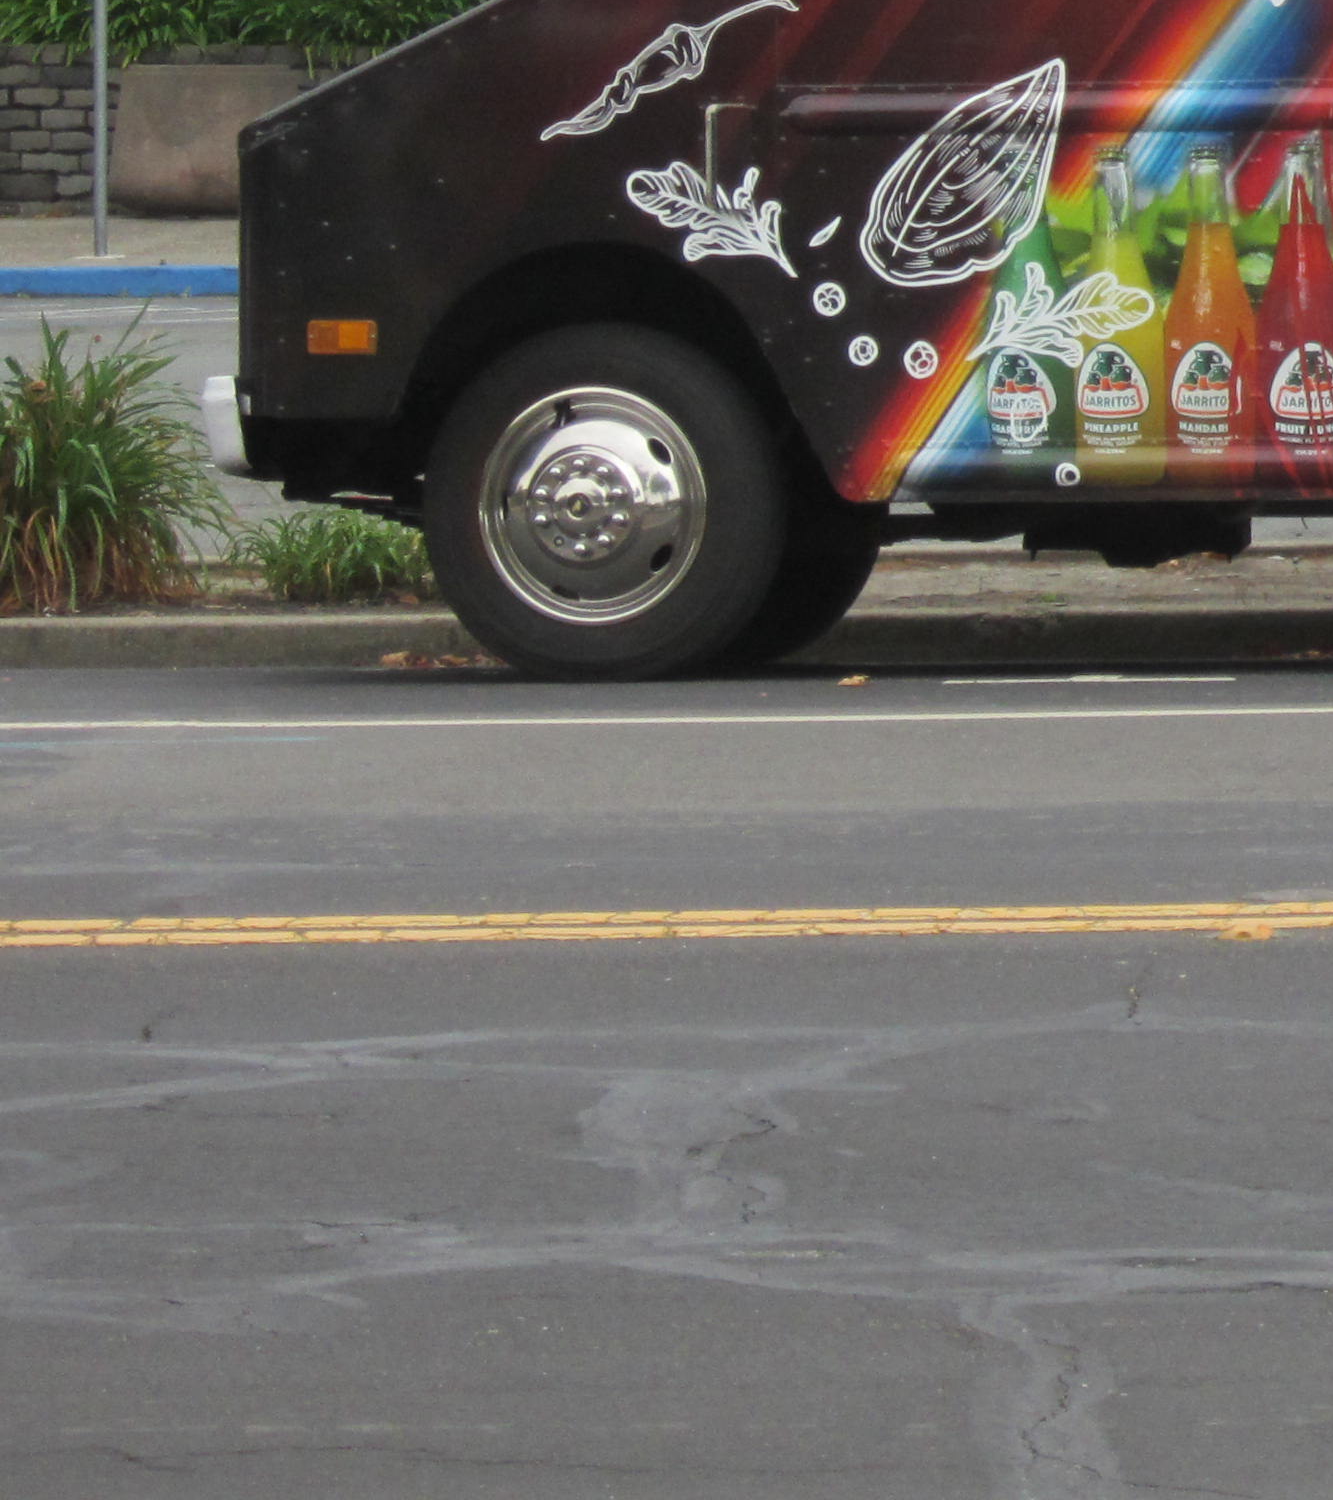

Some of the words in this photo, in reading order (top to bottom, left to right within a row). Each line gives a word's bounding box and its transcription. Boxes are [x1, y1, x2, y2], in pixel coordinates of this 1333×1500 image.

[1085, 395, 1137, 408] JARRITOS
[1181, 395, 1228, 407] JARRITO
[1084, 422, 1139, 433] PINEAPPLE
[1179, 421, 1229, 433] MANDARI
[1275, 422, 1306, 435] FRUIT
